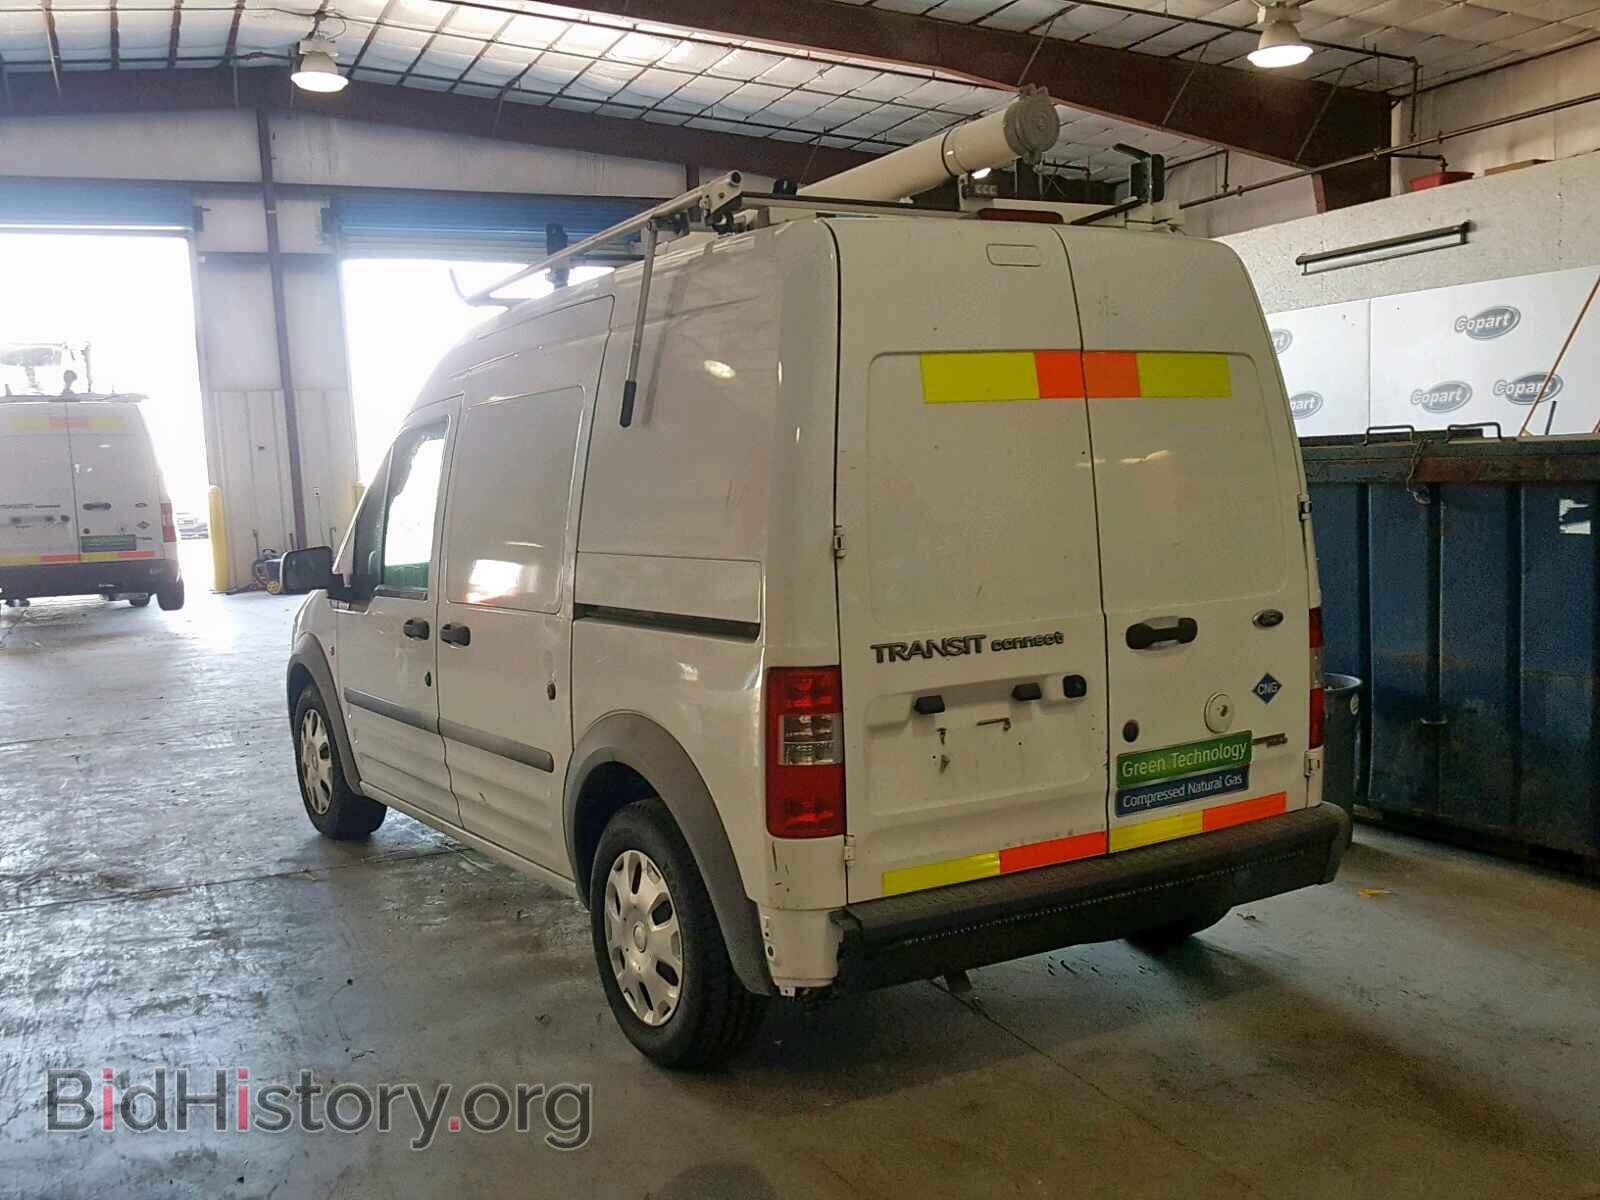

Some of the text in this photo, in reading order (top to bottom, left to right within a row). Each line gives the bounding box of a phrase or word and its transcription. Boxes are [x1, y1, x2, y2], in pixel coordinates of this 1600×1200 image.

[1454, 309, 1512, 333] Copart
[1411, 389, 1463, 406] Copart
[870, 631, 1065, 664] TRANSIT connect
[1122, 742, 1248, 778] Green Technology
[1122, 773, 1243, 808] Compressed Natural Gas
